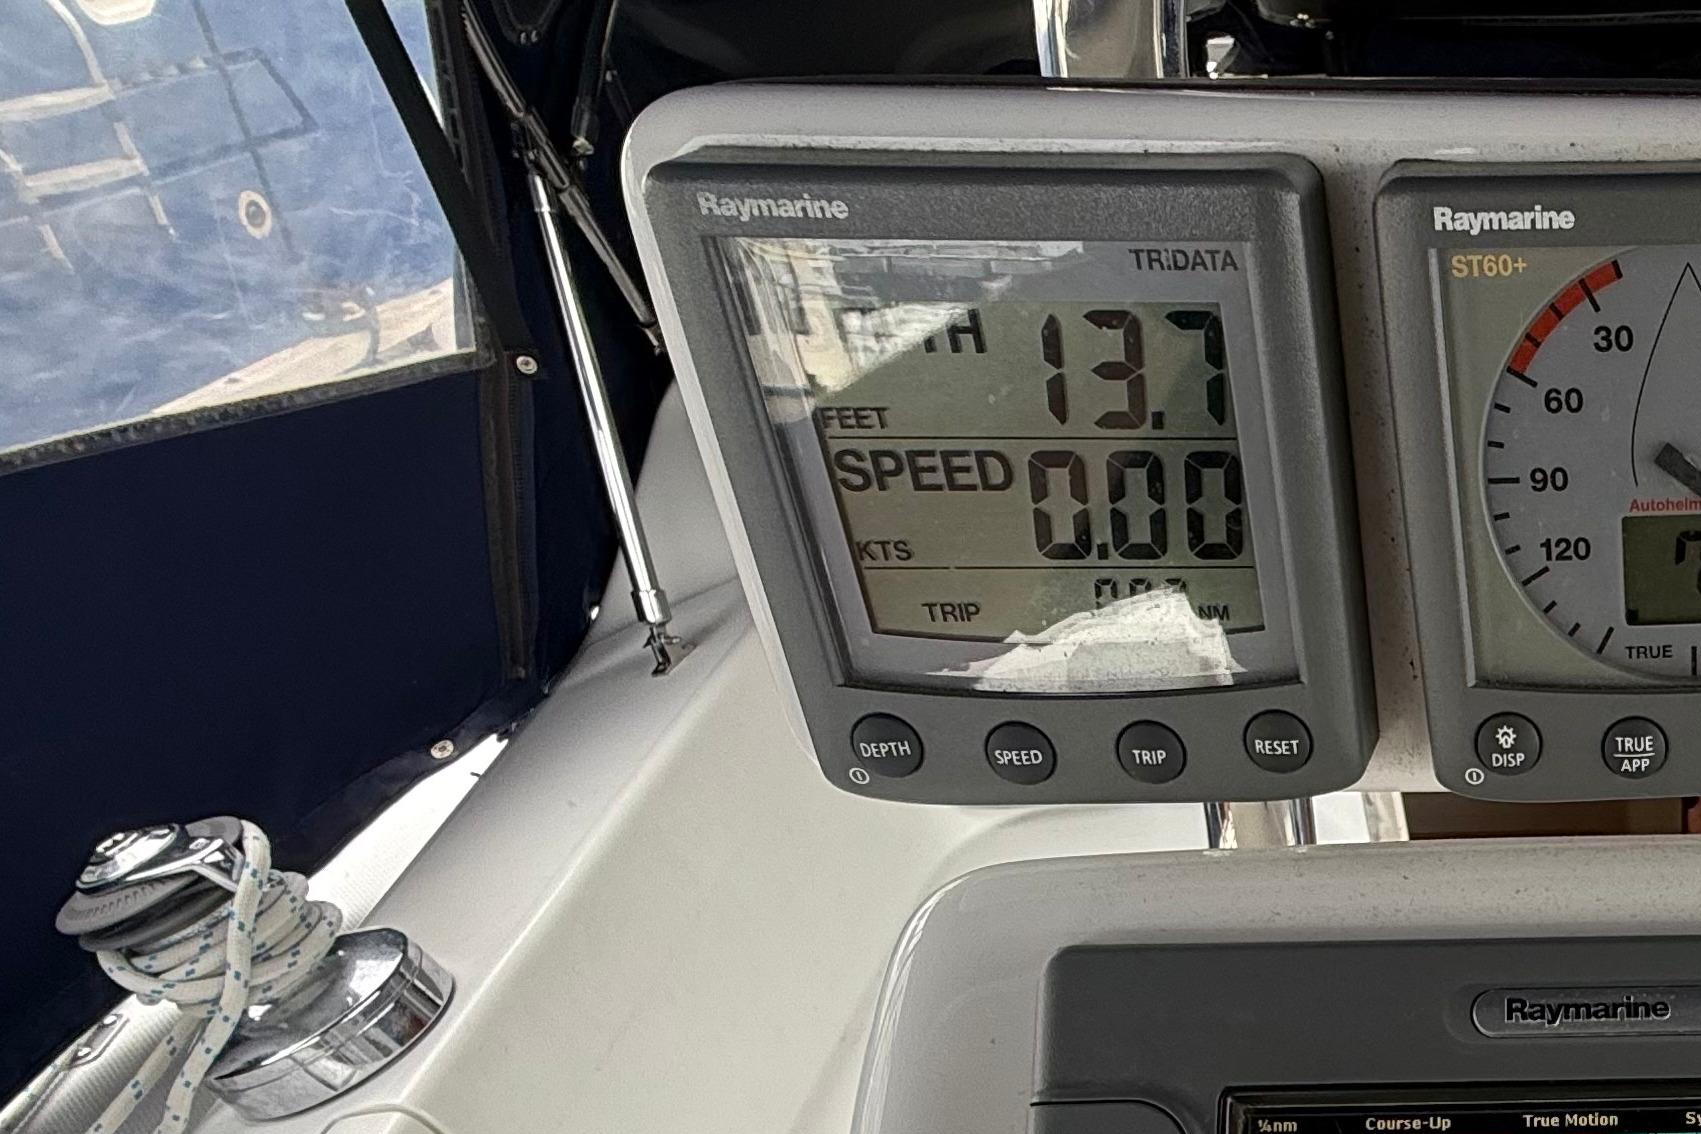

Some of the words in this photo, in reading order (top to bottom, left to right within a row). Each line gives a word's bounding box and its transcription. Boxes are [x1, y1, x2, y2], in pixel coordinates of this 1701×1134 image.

[699, 192, 850, 222] Raymarine
[1433, 205, 1576, 236] Raymarine
[1129, 248, 1239, 273] TRIDATA
[1451, 255, 1528, 279] ST60+
[1593, 325, 1635, 353] 30
[1040, 309, 1227, 430] 13.7
[1543, 387, 1584, 414] 60
[819, 406, 890, 430] FEET
[1529, 466, 1569, 492] 90
[837, 448, 1015, 492] SPEED
[1027, 449, 1246, 561] 0.00
[857, 539, 913, 563] KTS
[1539, 536, 1592, 563] 120
[922, 601, 981, 624] TRIP
[1625, 644, 1674, 662] TRUE
[859, 739, 912, 760] DEPTH
[1254, 738, 1300, 757] RESET
[1615, 735, 1655, 752] TRUE
[993, 748, 1043, 766] SPEED
[1131, 749, 1168, 765] TRIP
[1491, 752, 1526, 769] DISP
[1620, 757, 1651, 773] APP
[1504, 995, 1671, 1027] Raymarine
[1365, 1117, 1452, 1132] Course-Up
[1522, 1114, 1560, 1128] True
[1565, 1112, 1619, 1128] Motion
